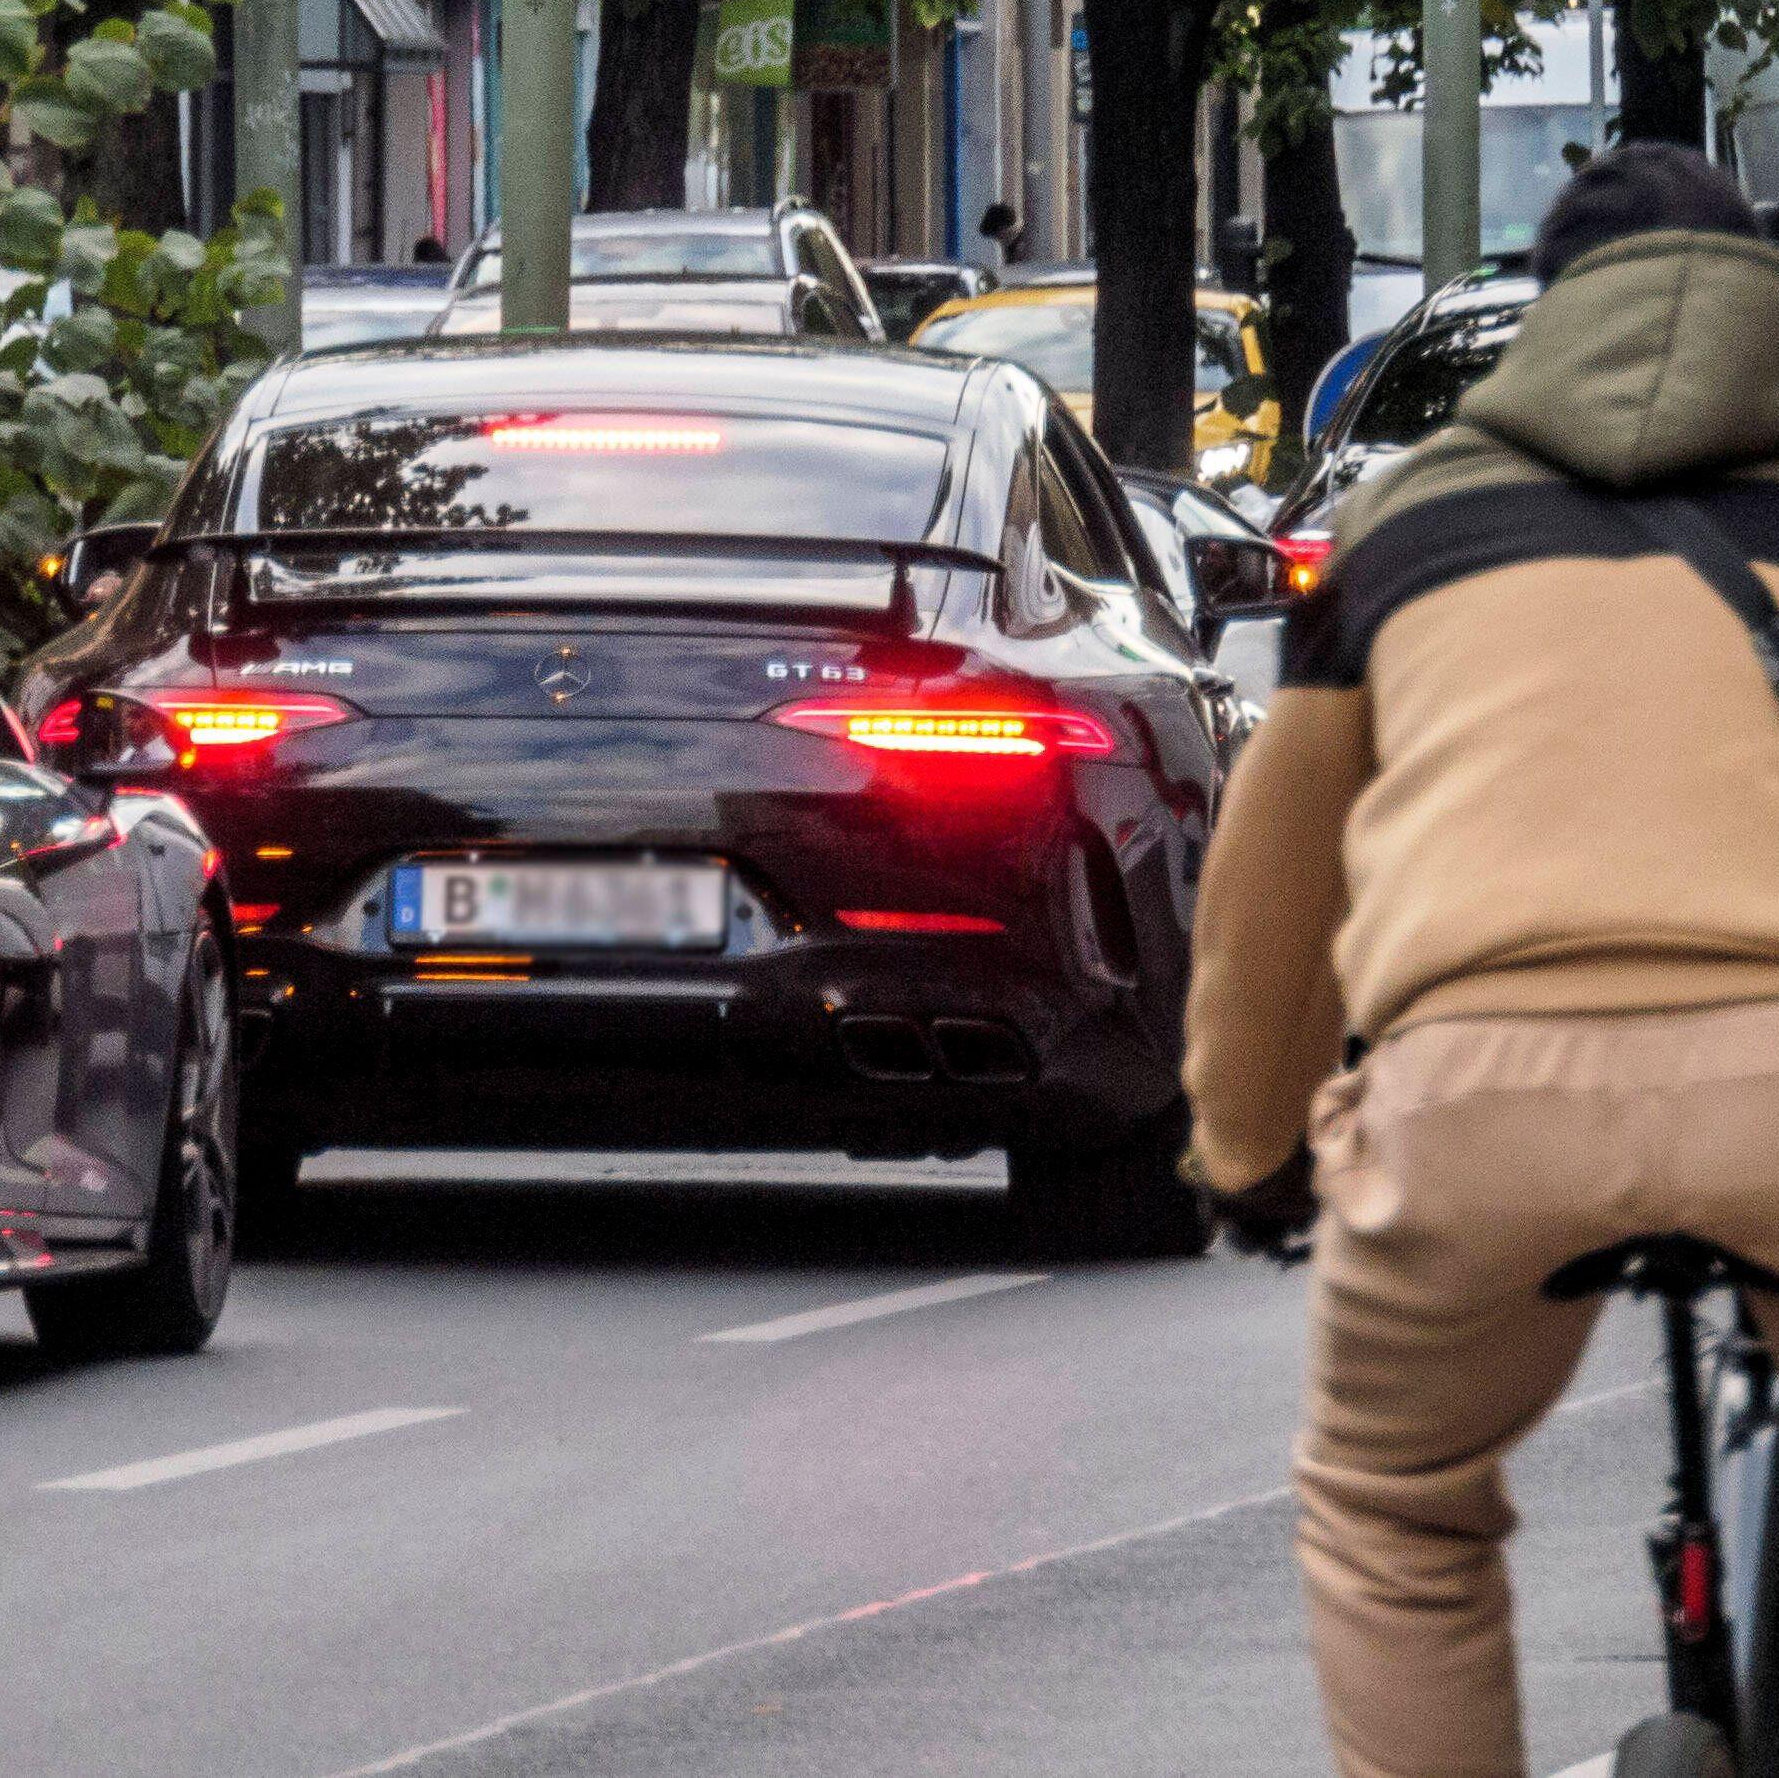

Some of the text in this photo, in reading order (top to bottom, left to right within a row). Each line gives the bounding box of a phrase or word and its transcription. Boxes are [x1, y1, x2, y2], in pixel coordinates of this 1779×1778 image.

[715, 15, 793, 73] eis
[766, 664, 865, 682] GT 63
